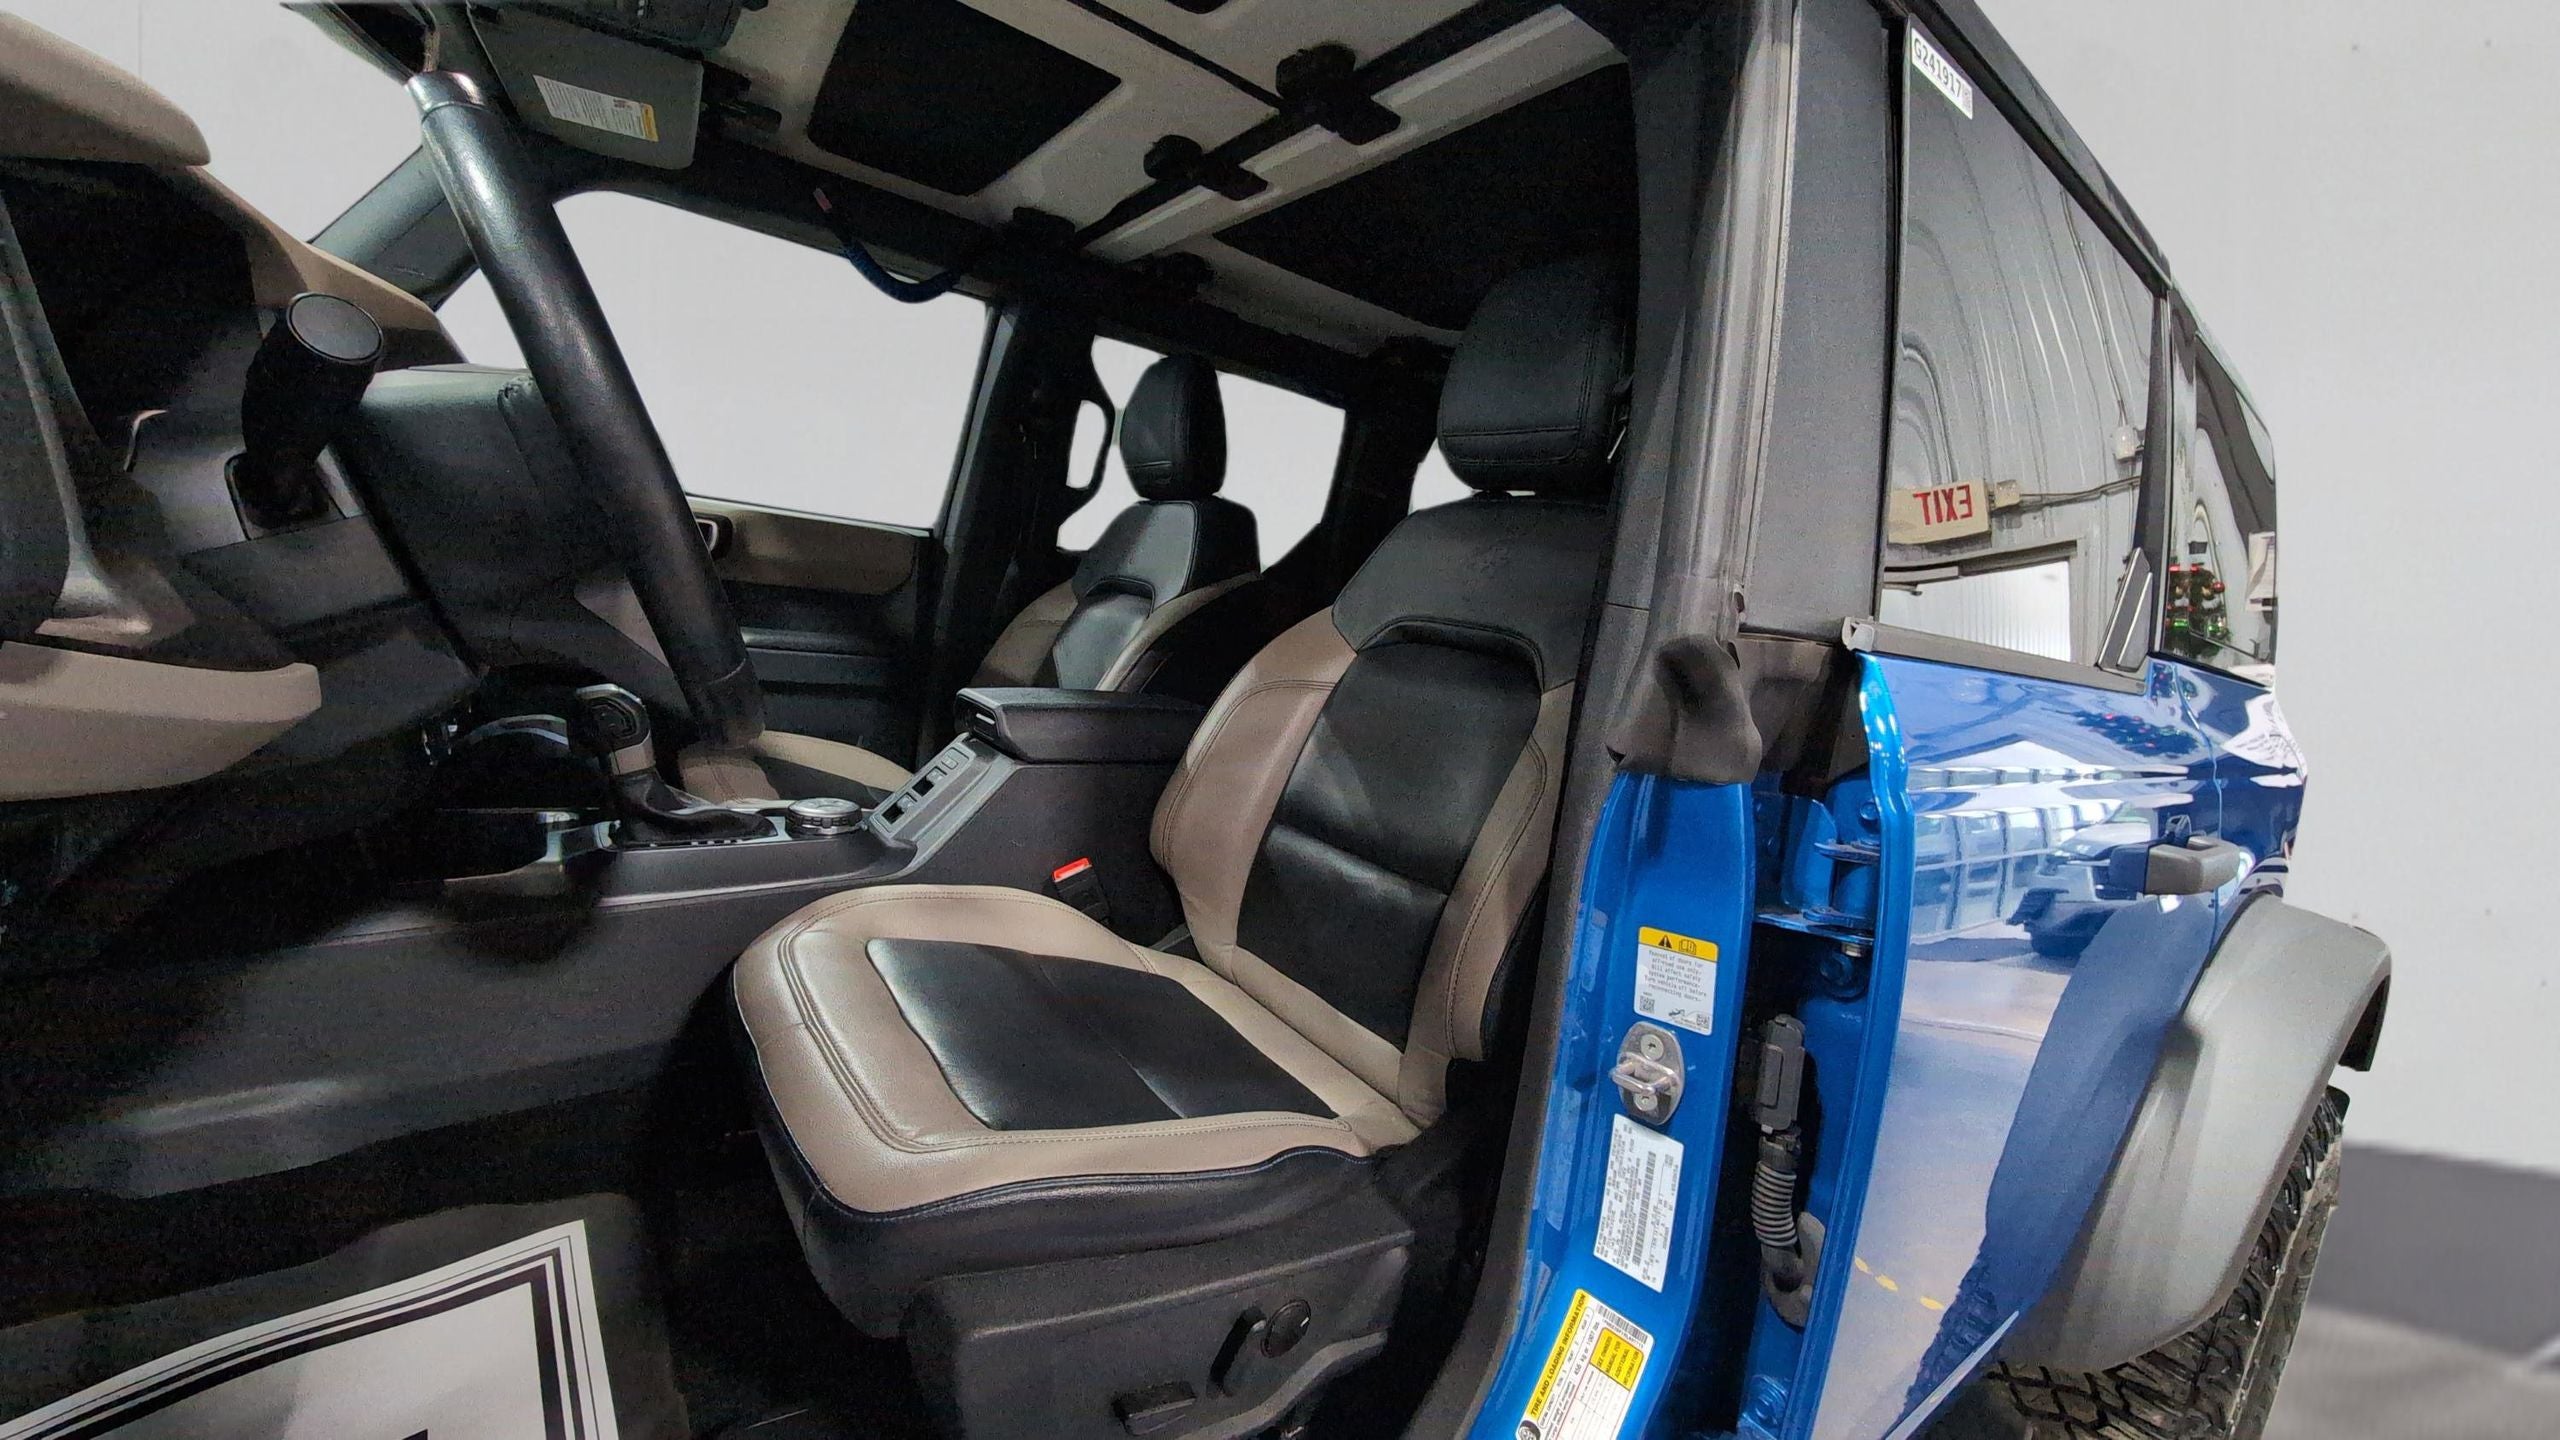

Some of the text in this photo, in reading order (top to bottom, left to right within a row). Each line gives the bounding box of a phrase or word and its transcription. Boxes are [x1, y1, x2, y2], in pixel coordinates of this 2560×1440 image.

[1913, 37, 1962, 98] G241917
[1531, 1397, 1542, 1416] TIRE
[1540, 1380, 1550, 1397] AND
[1547, 1346, 1565, 1379] LOADING
[1562, 1293, 1586, 1345] INFORMATION
